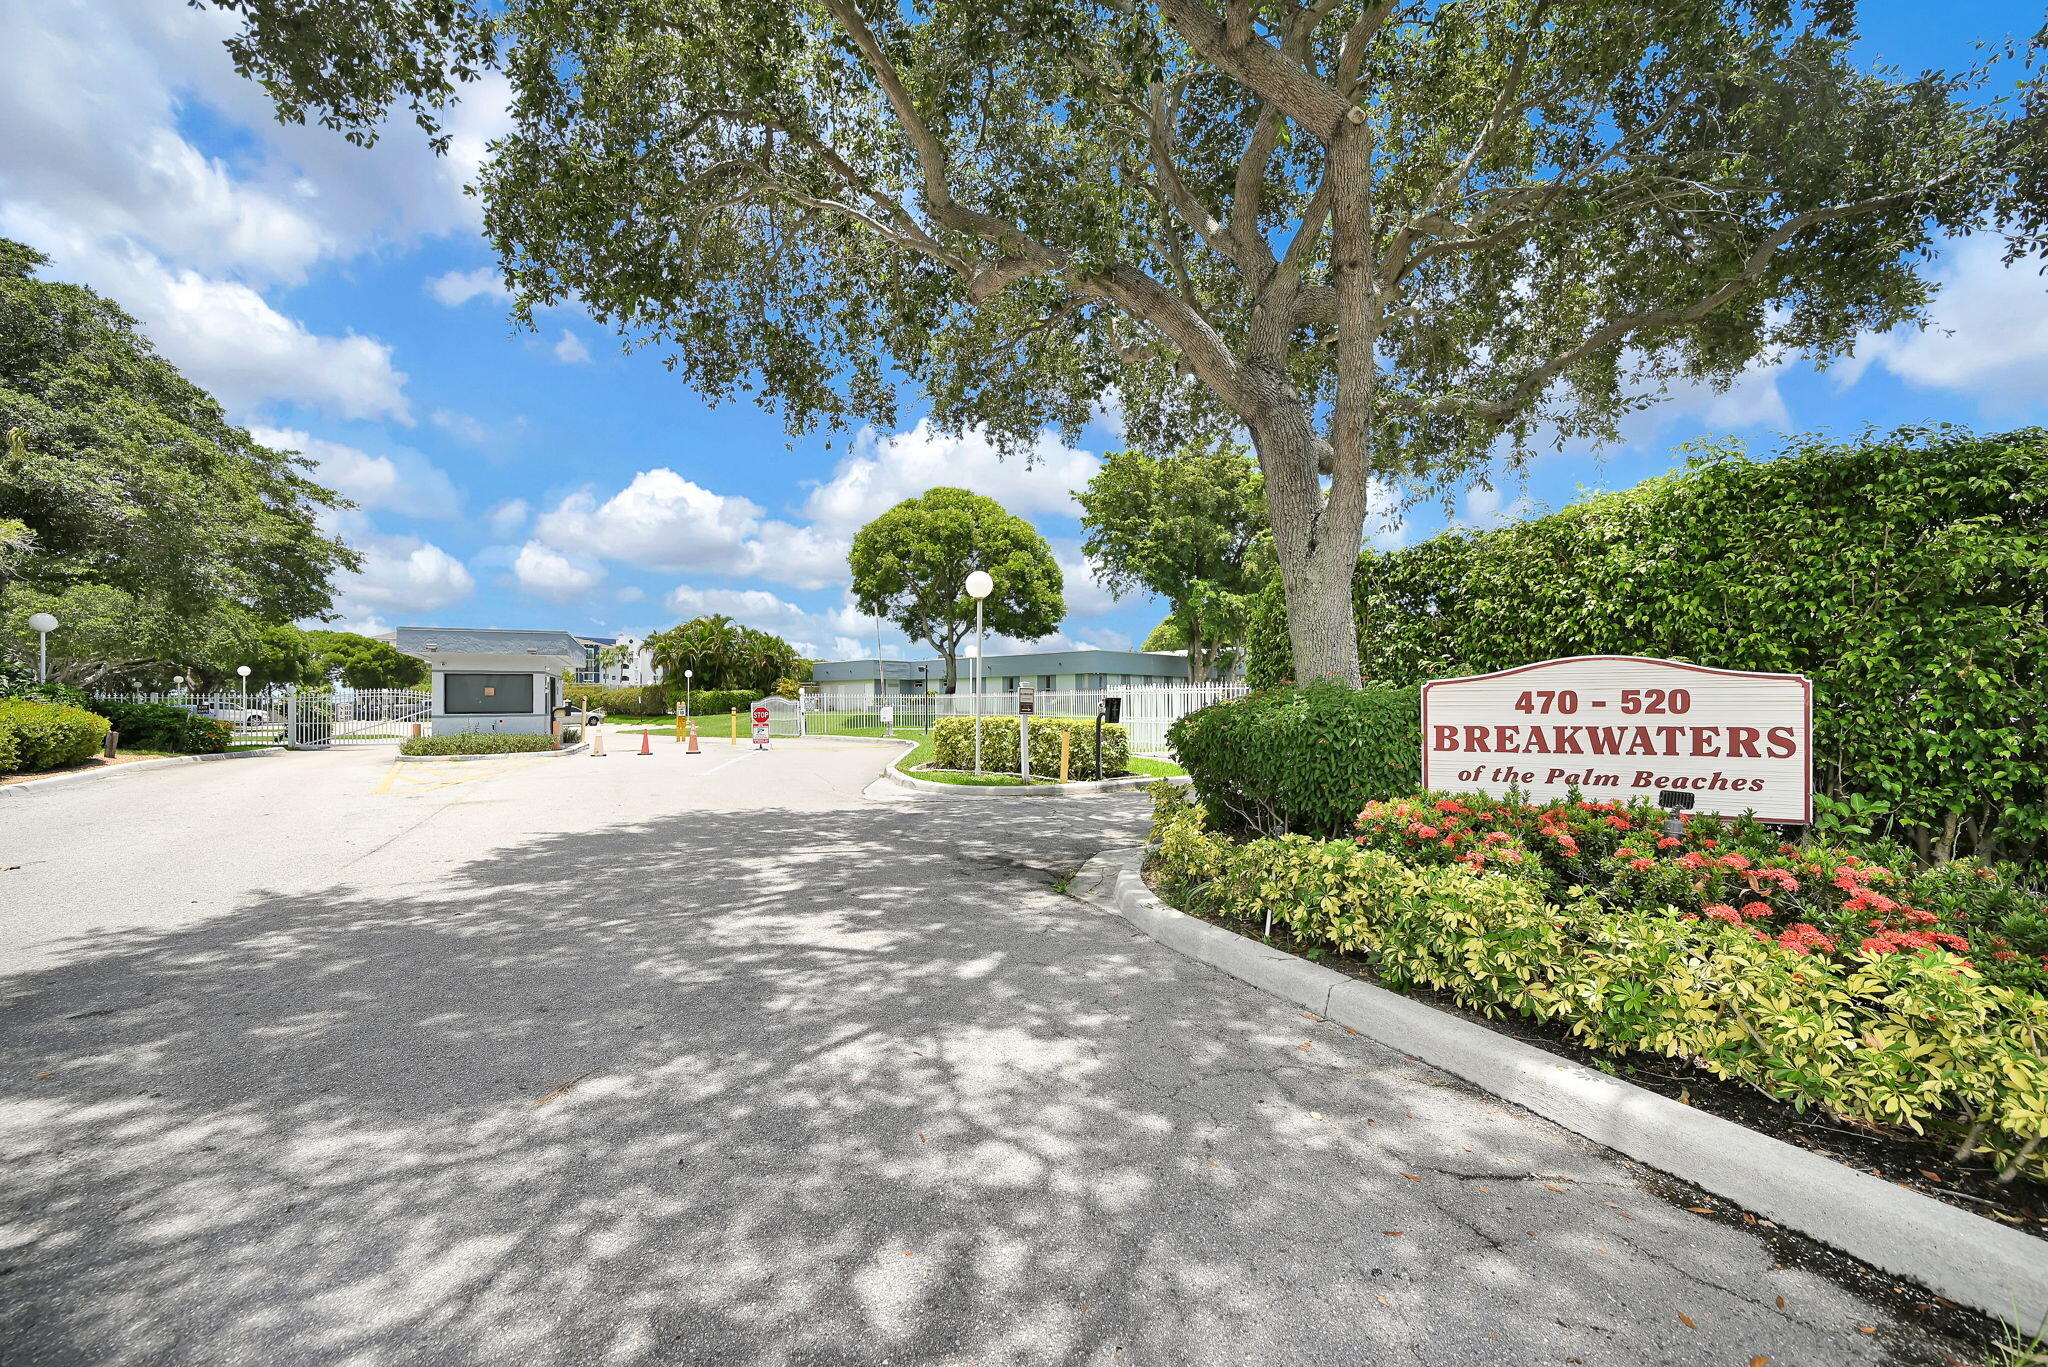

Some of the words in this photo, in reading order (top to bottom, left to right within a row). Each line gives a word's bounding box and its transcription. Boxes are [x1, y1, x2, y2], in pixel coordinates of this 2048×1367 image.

[753, 711, 769, 719] STOP
[1514, 690, 1579, 715] 470
[1621, 688, 1691, 715] 520
[1433, 725, 1797, 759] BREAKWATERS
[1457, 765, 1486, 782] of
[1491, 766, 1535, 784] the
[1545, 768, 1620, 787] Palm
[1631, 770, 1765, 792] Beaches
